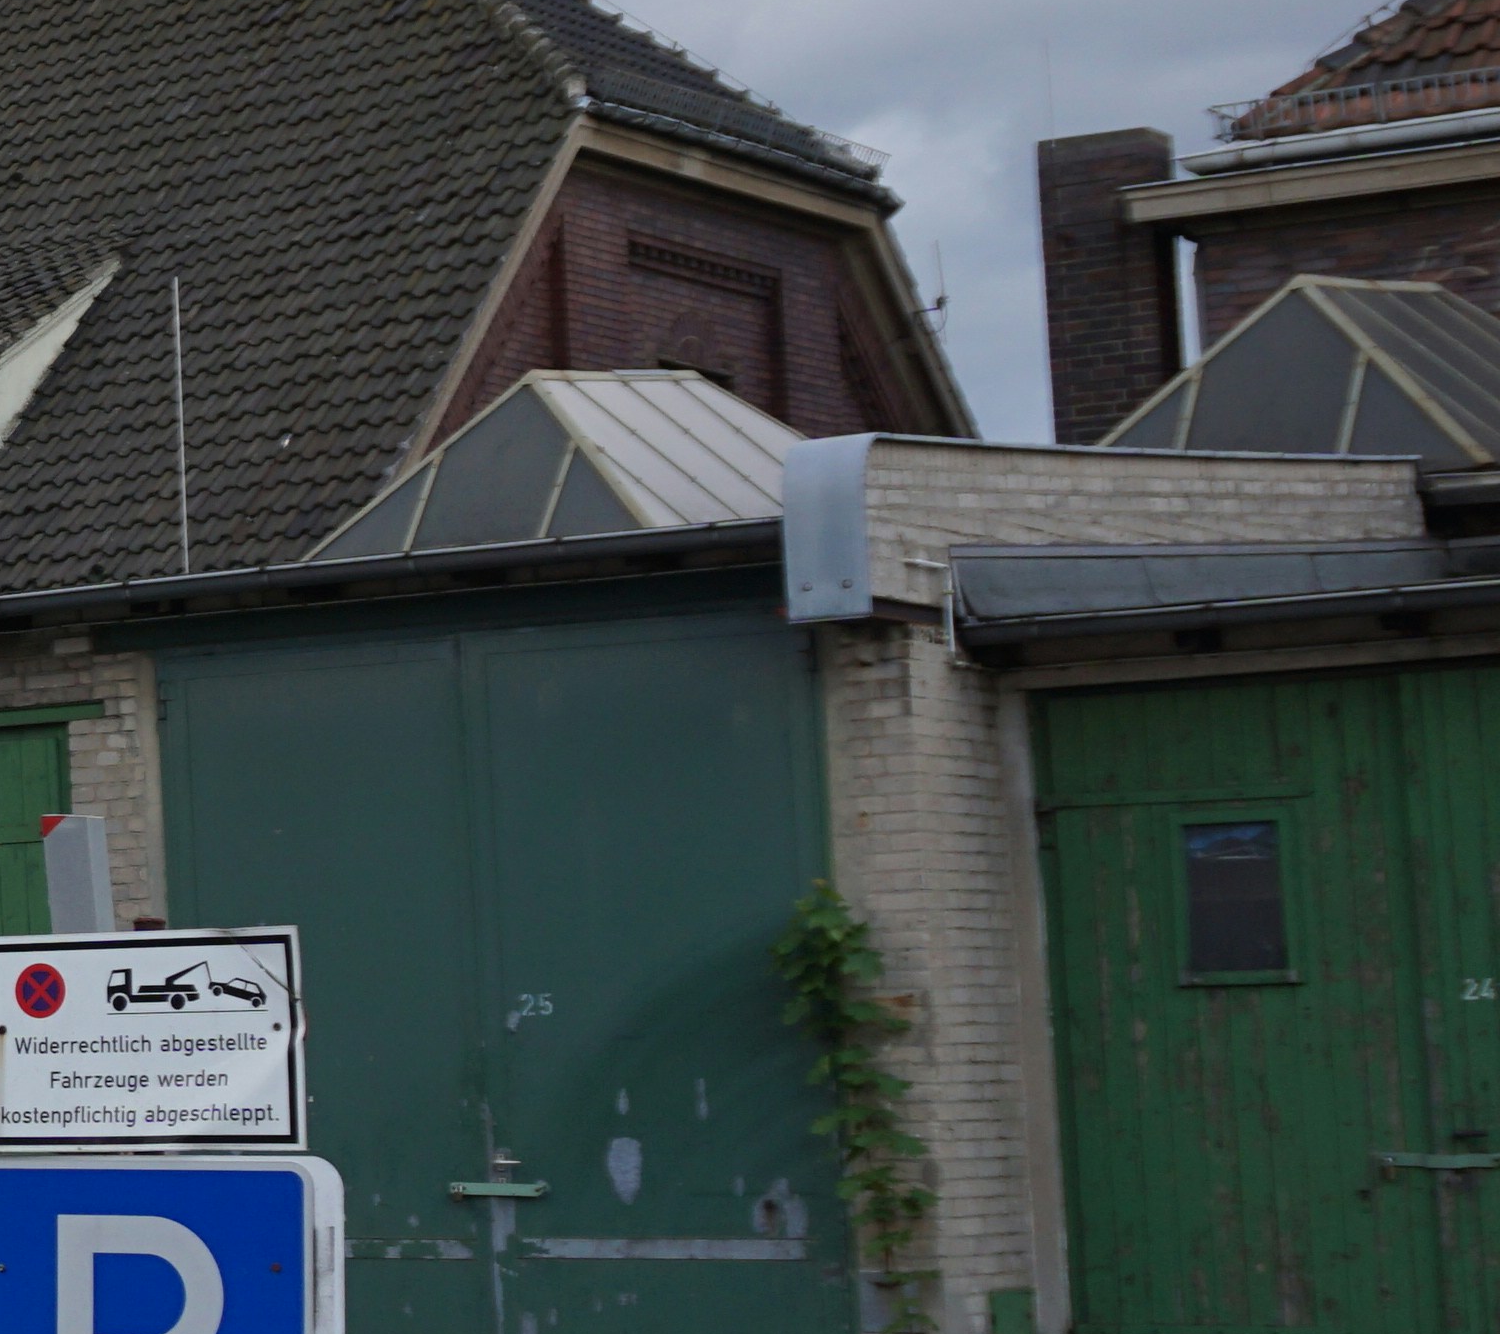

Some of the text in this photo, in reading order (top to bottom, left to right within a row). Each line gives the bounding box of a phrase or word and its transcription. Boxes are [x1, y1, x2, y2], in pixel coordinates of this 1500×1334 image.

[1463, 978, 1495, 1000] 24
[520, 993, 553, 1015] 25
[14, 1033, 268, 1057] Widerrechtlich abgestellte
[49, 1069, 229, 1093] Fahrzeuge werden
[0, 1103, 280, 1128] kostenpflichtig abgeschleppt.
